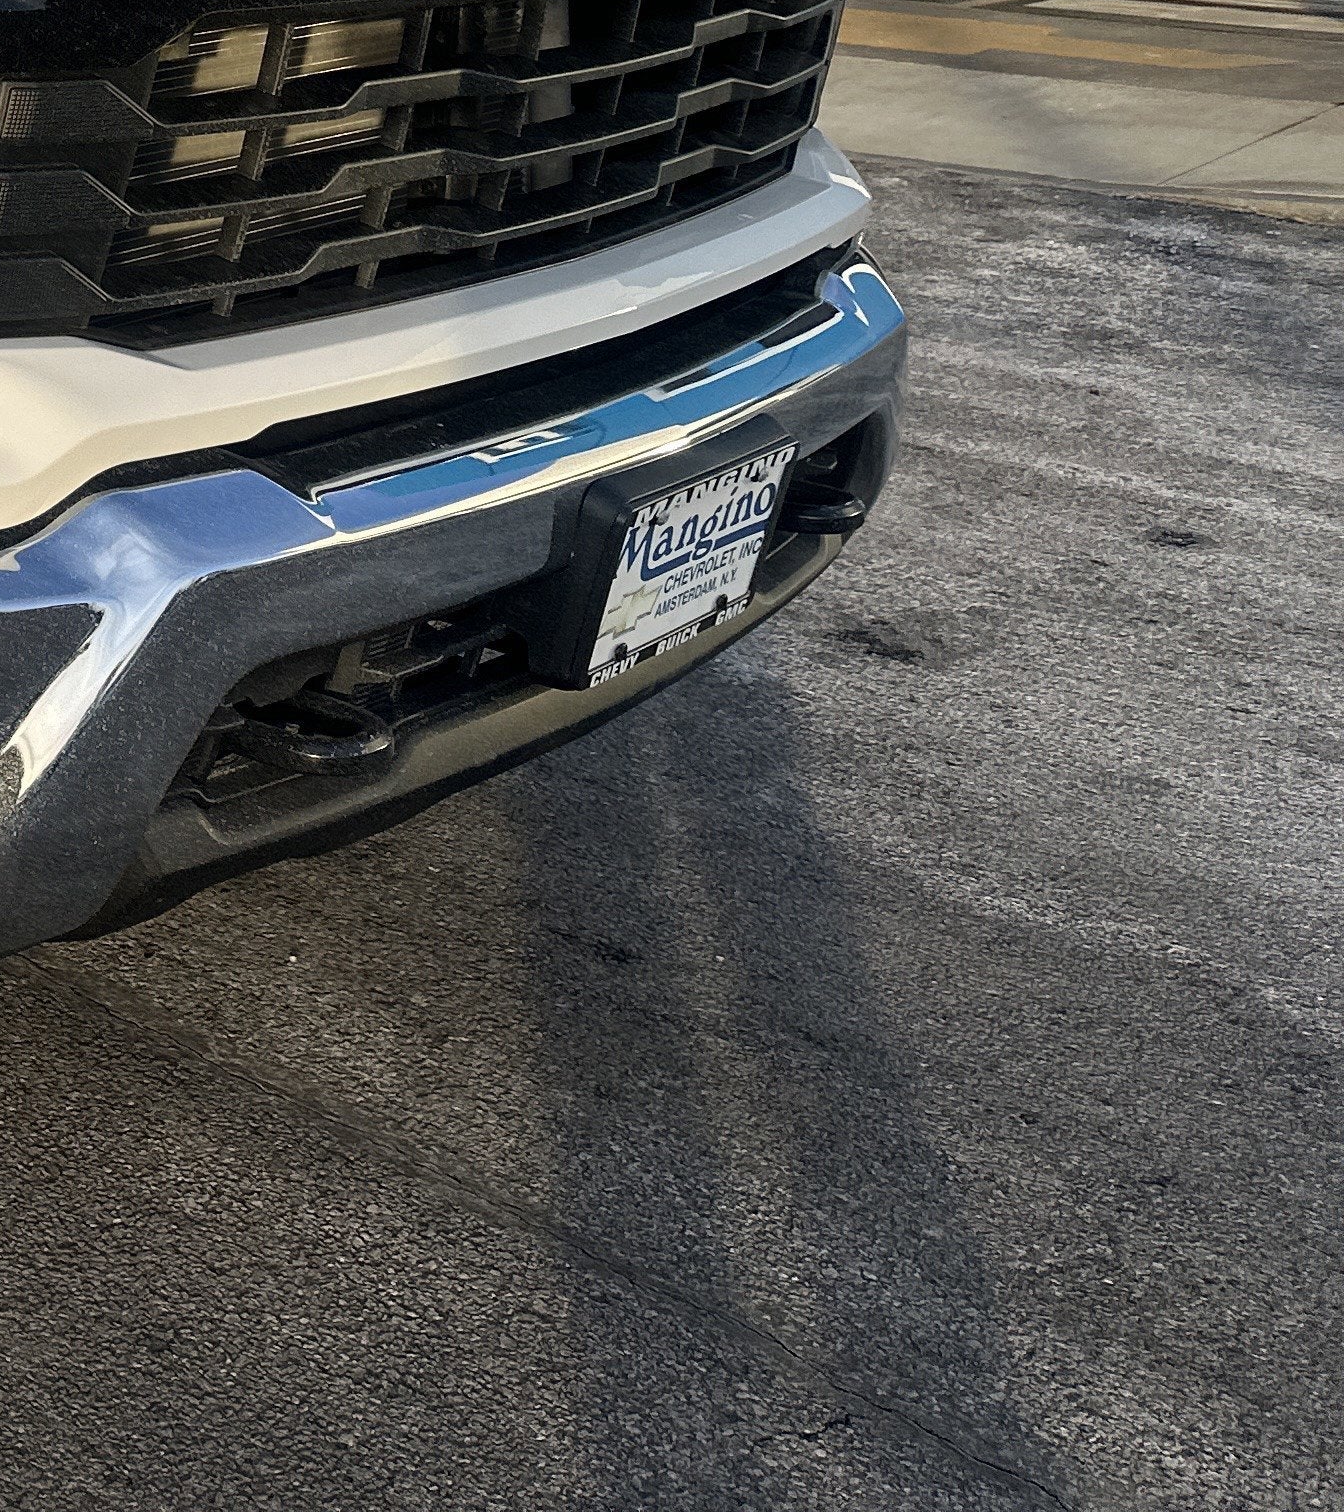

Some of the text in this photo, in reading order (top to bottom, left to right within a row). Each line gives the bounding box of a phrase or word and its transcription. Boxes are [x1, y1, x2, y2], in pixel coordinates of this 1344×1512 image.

[634, 445, 796, 528] MANGINO
[618, 482, 777, 582] Mangino
[664, 546, 737, 593] CHEVROLET,
[589, 598, 750, 688] CHEVY BUICK GMC
